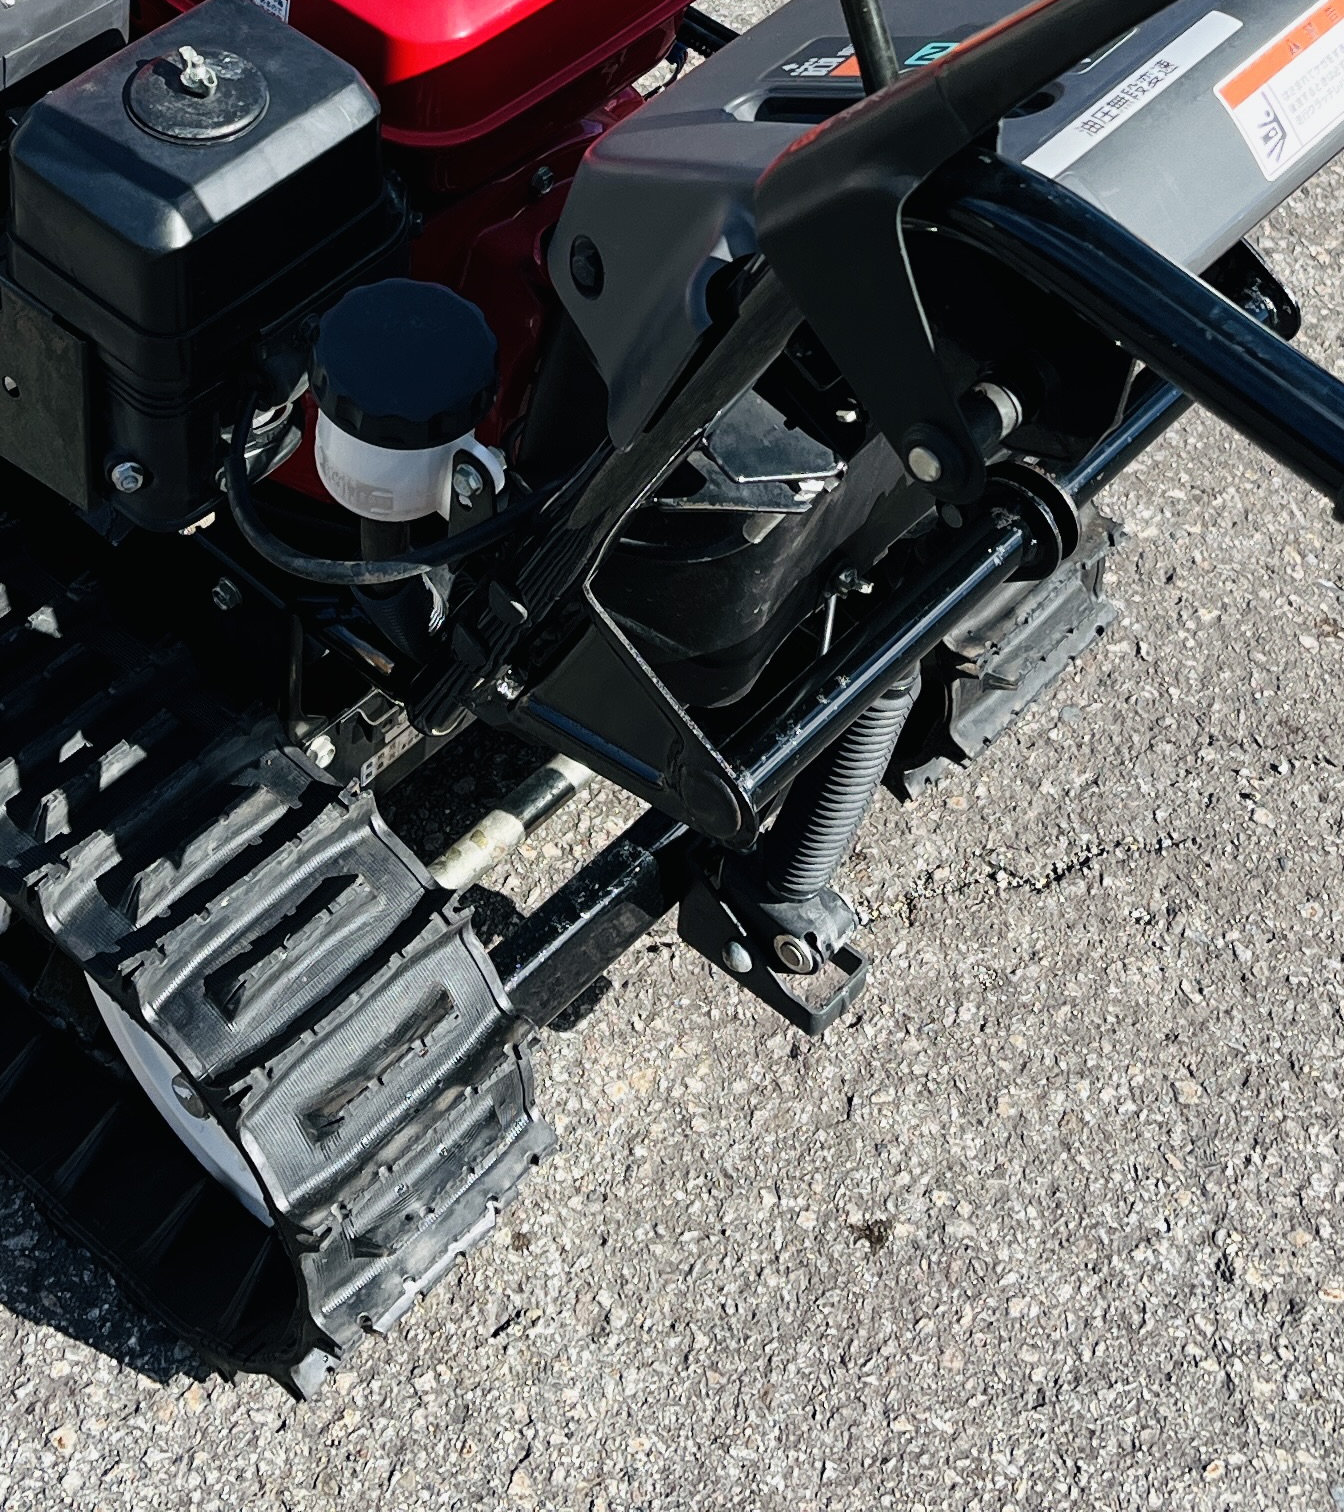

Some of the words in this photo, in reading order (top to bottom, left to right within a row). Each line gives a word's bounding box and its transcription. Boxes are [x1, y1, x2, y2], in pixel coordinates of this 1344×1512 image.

[1074, 59, 1179, 136] 油圧無段変速
